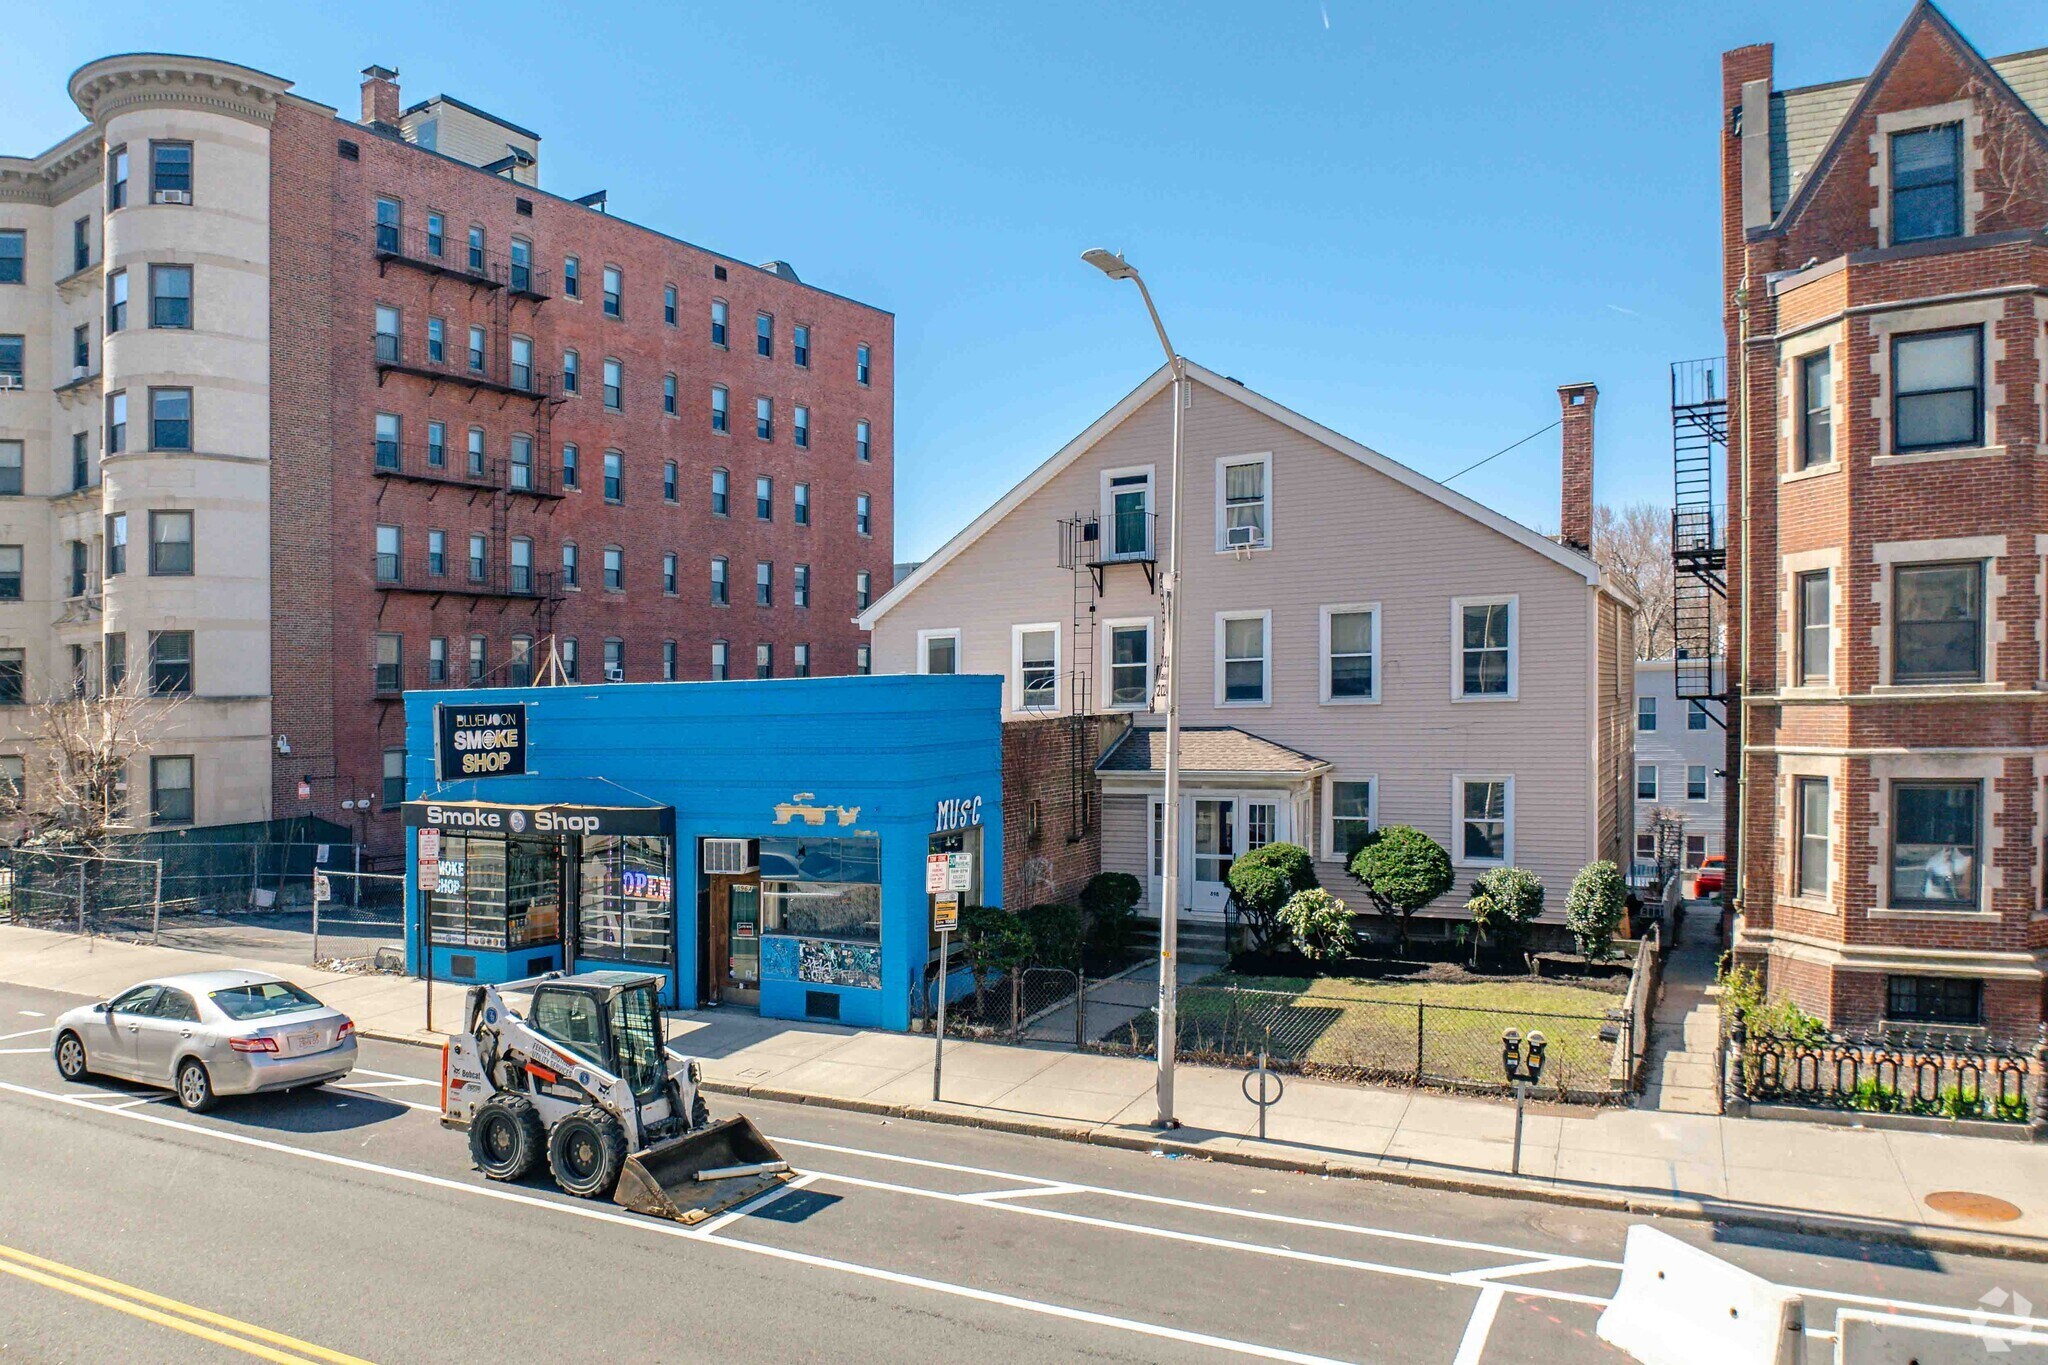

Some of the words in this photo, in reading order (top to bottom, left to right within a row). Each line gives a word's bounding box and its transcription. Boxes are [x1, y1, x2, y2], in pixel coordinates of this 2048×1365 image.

[456, 713, 516, 727] BLUEMOON
[454, 728, 519, 751] SMOKE
[462, 752, 511, 774] SHOP
[427, 805, 501, 827] Smoke
[534, 811, 600, 835] Shop
[438, 860, 465, 877] MOKE
[623, 871, 671, 902] OPEN
[462, 1069, 481, 1080] Bobcat
